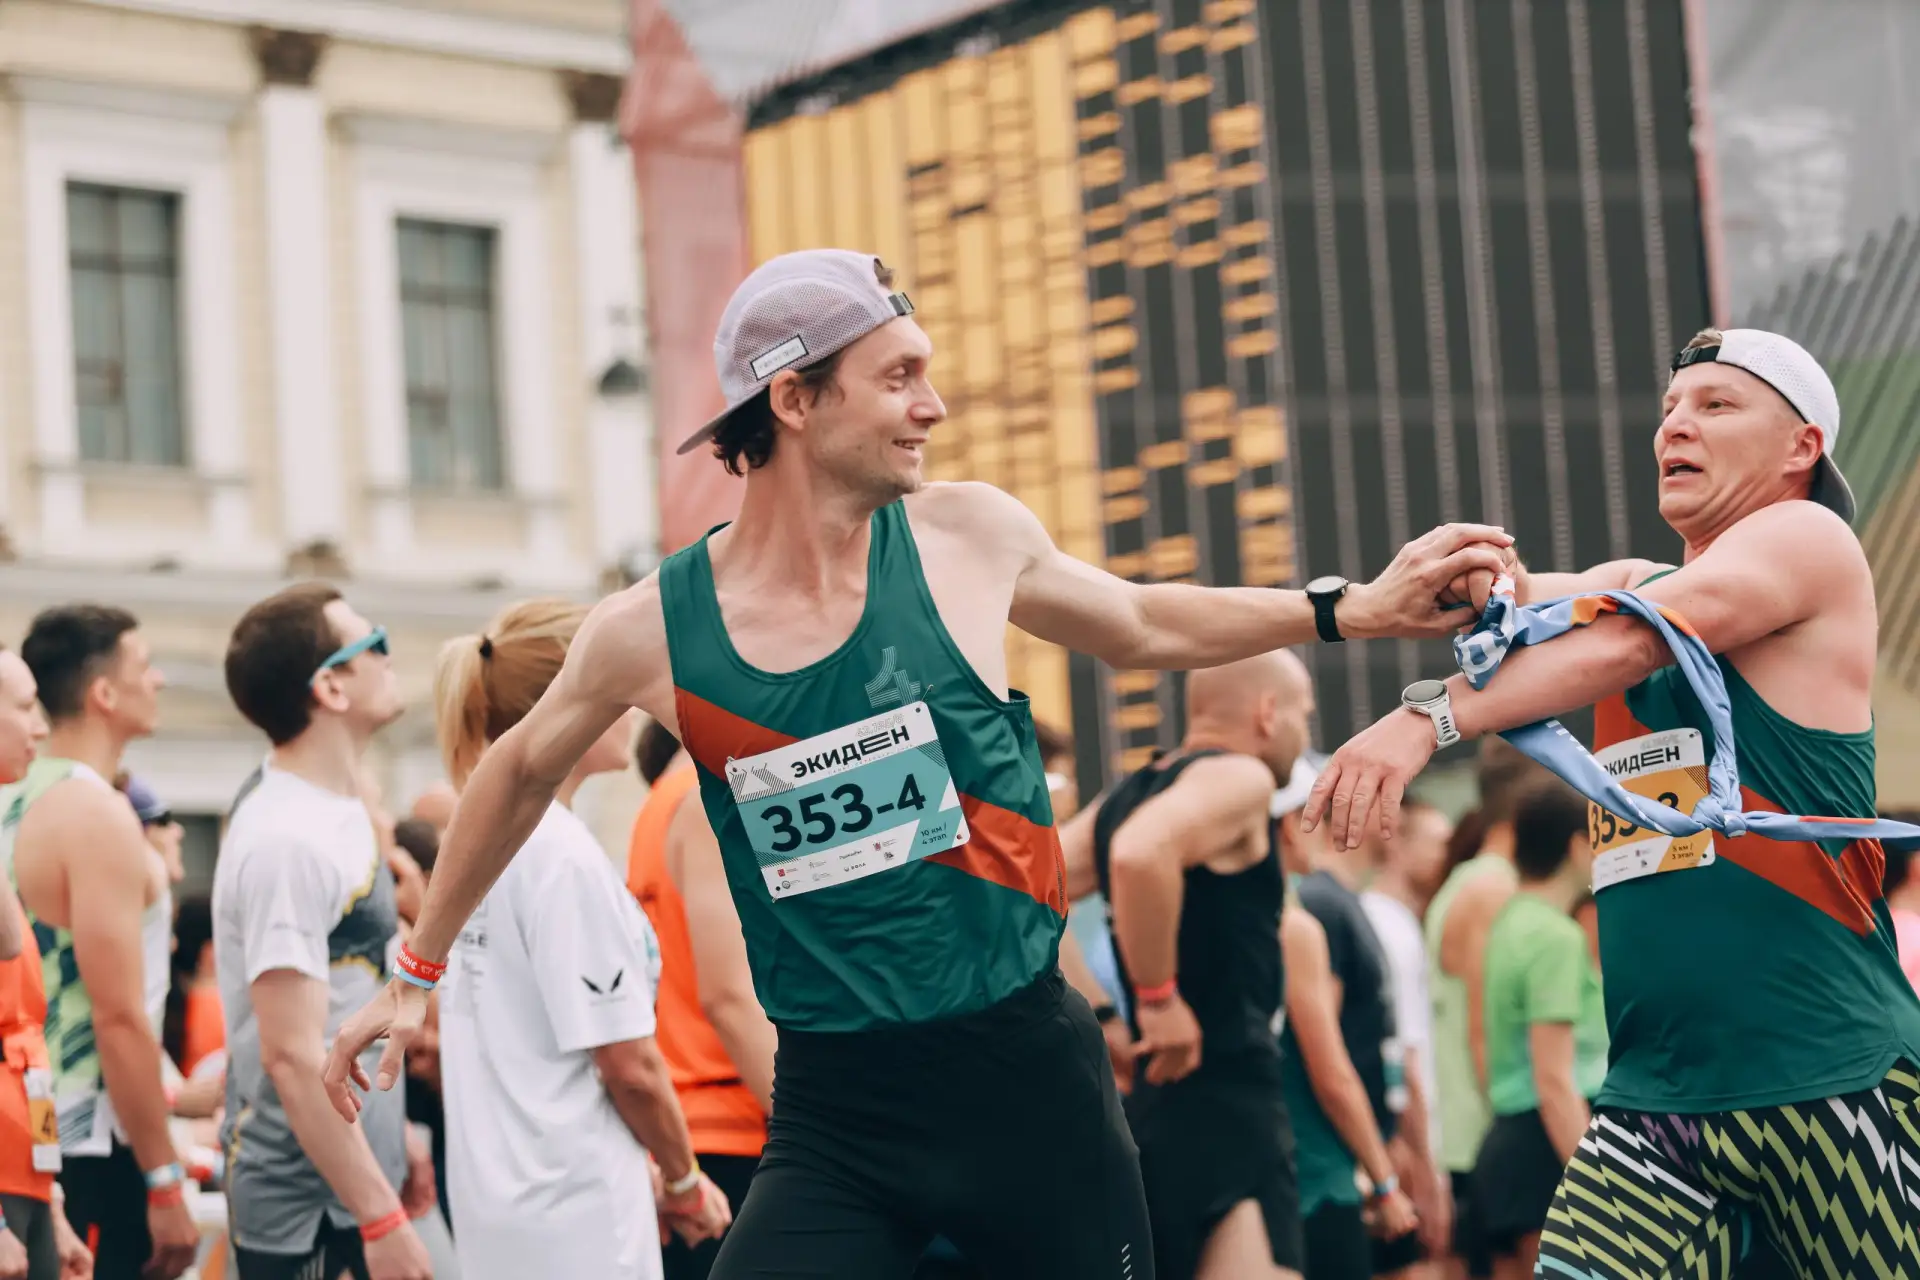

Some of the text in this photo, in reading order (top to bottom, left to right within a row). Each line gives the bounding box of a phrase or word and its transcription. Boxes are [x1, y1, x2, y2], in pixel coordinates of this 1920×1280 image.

[790, 724, 911, 778] ЭКИДЕН
[1603, 745, 1681, 776] КИДЕН
[760, 773, 927, 852] 353-4
[920, 829, 930, 837] 10
[931, 825, 943, 834] км
[929, 833, 947, 843] этап
